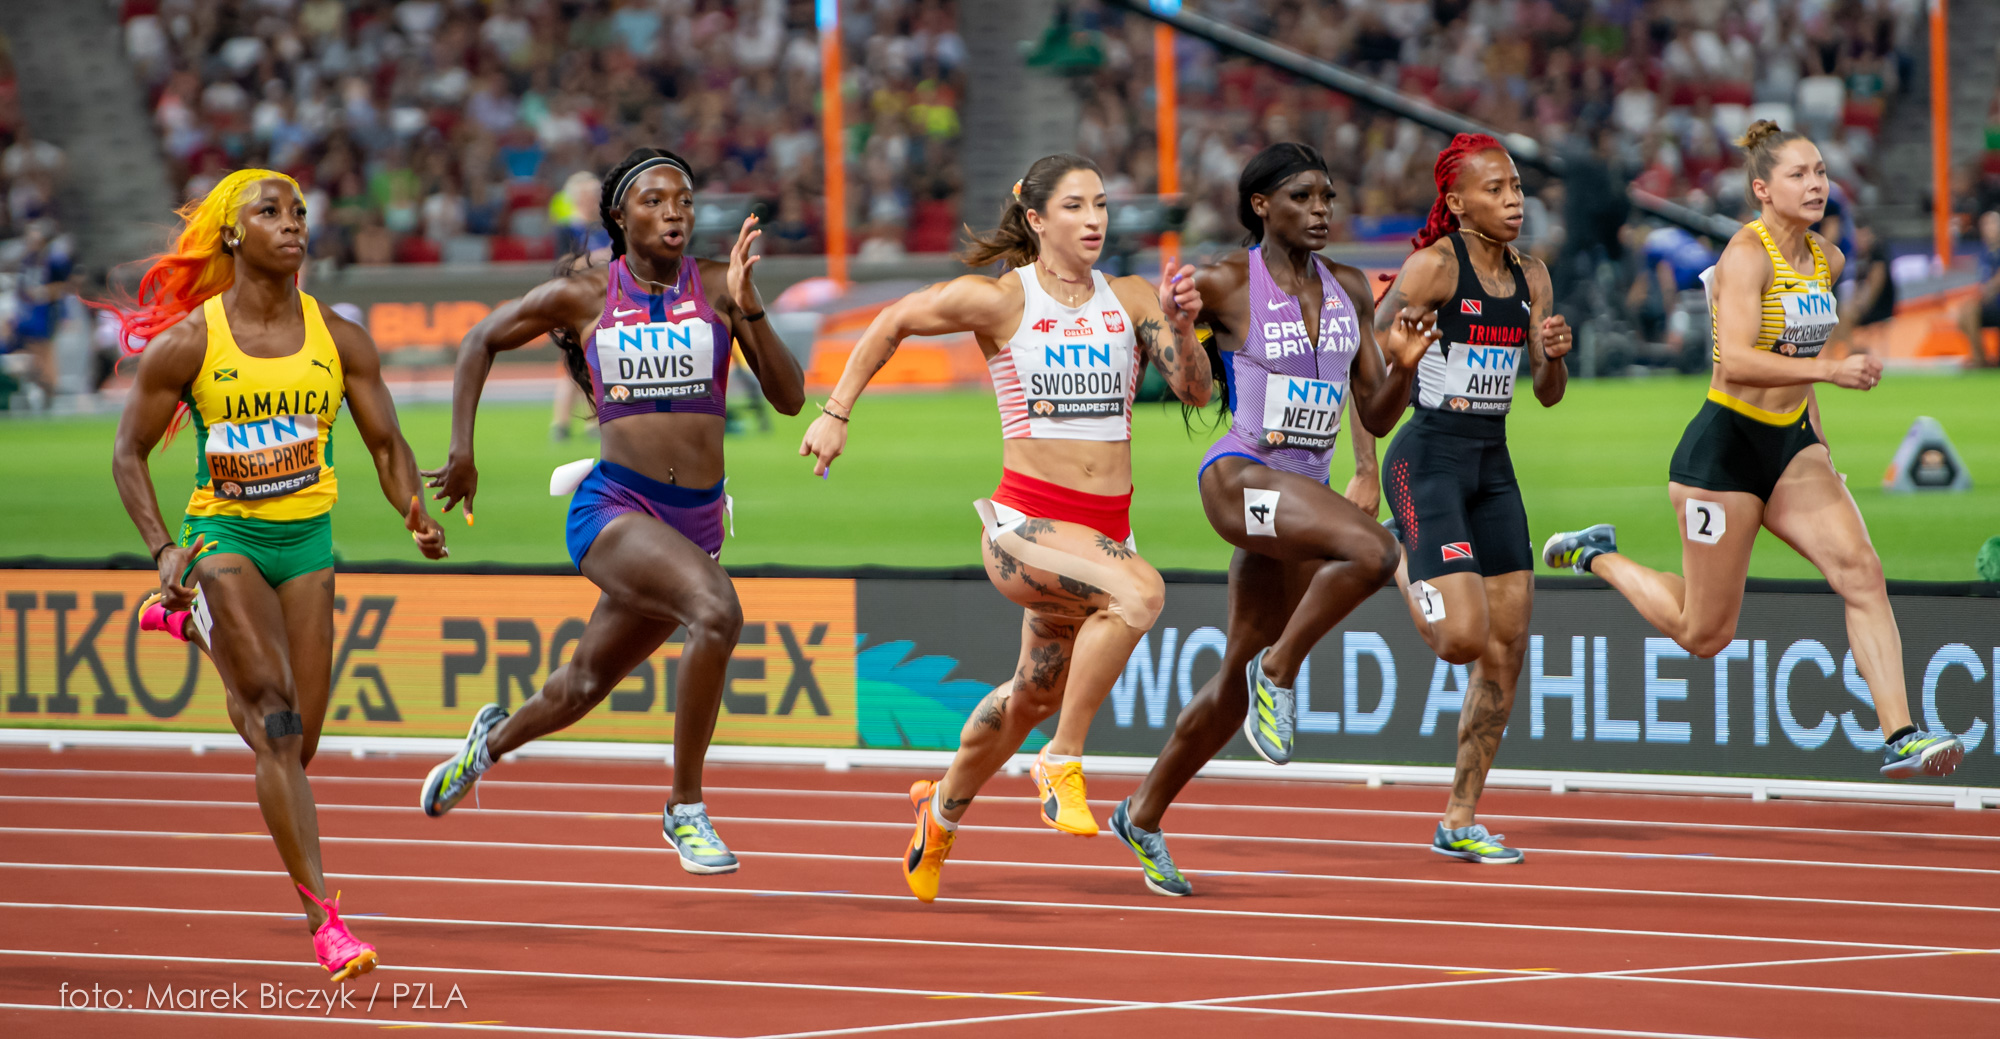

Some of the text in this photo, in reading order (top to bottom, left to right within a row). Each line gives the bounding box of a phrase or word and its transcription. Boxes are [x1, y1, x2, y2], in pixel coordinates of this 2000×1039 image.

[1797, 293, 1831, 316] NTN
[618, 326, 692, 352] NTN
[1065, 328, 1092, 337] ORLEN
[1264, 316, 1351, 339] GREAT
[1045, 343, 1111, 369] NTN
[1265, 336, 1358, 359] BRITAIN
[1467, 347, 1516, 371] NTN
[618, 354, 694, 380] DAVIS
[633, 383, 706, 398] BUDAPEST 23
[1031, 372, 1122, 396] SWOBODA
[1287, 378, 1344, 406] NTN
[1466, 373, 1511, 396] AHYE
[222, 390, 329, 420] JAMAICA
[1057, 402, 1119, 413] BUDAPEST 23
[1281, 406, 1337, 432] NEITA
[226, 416, 299, 450] NTN
[210, 441, 315, 478] FRASER-PRYCE
[244, 476, 306, 496] BUDAPEST
[1249, 503, 1270, 525] 4
[1697, 506, 1713, 536] 2
[441, 616, 832, 716] PREX
[1108, 626, 2000, 755] WOLD AHLETICS C
